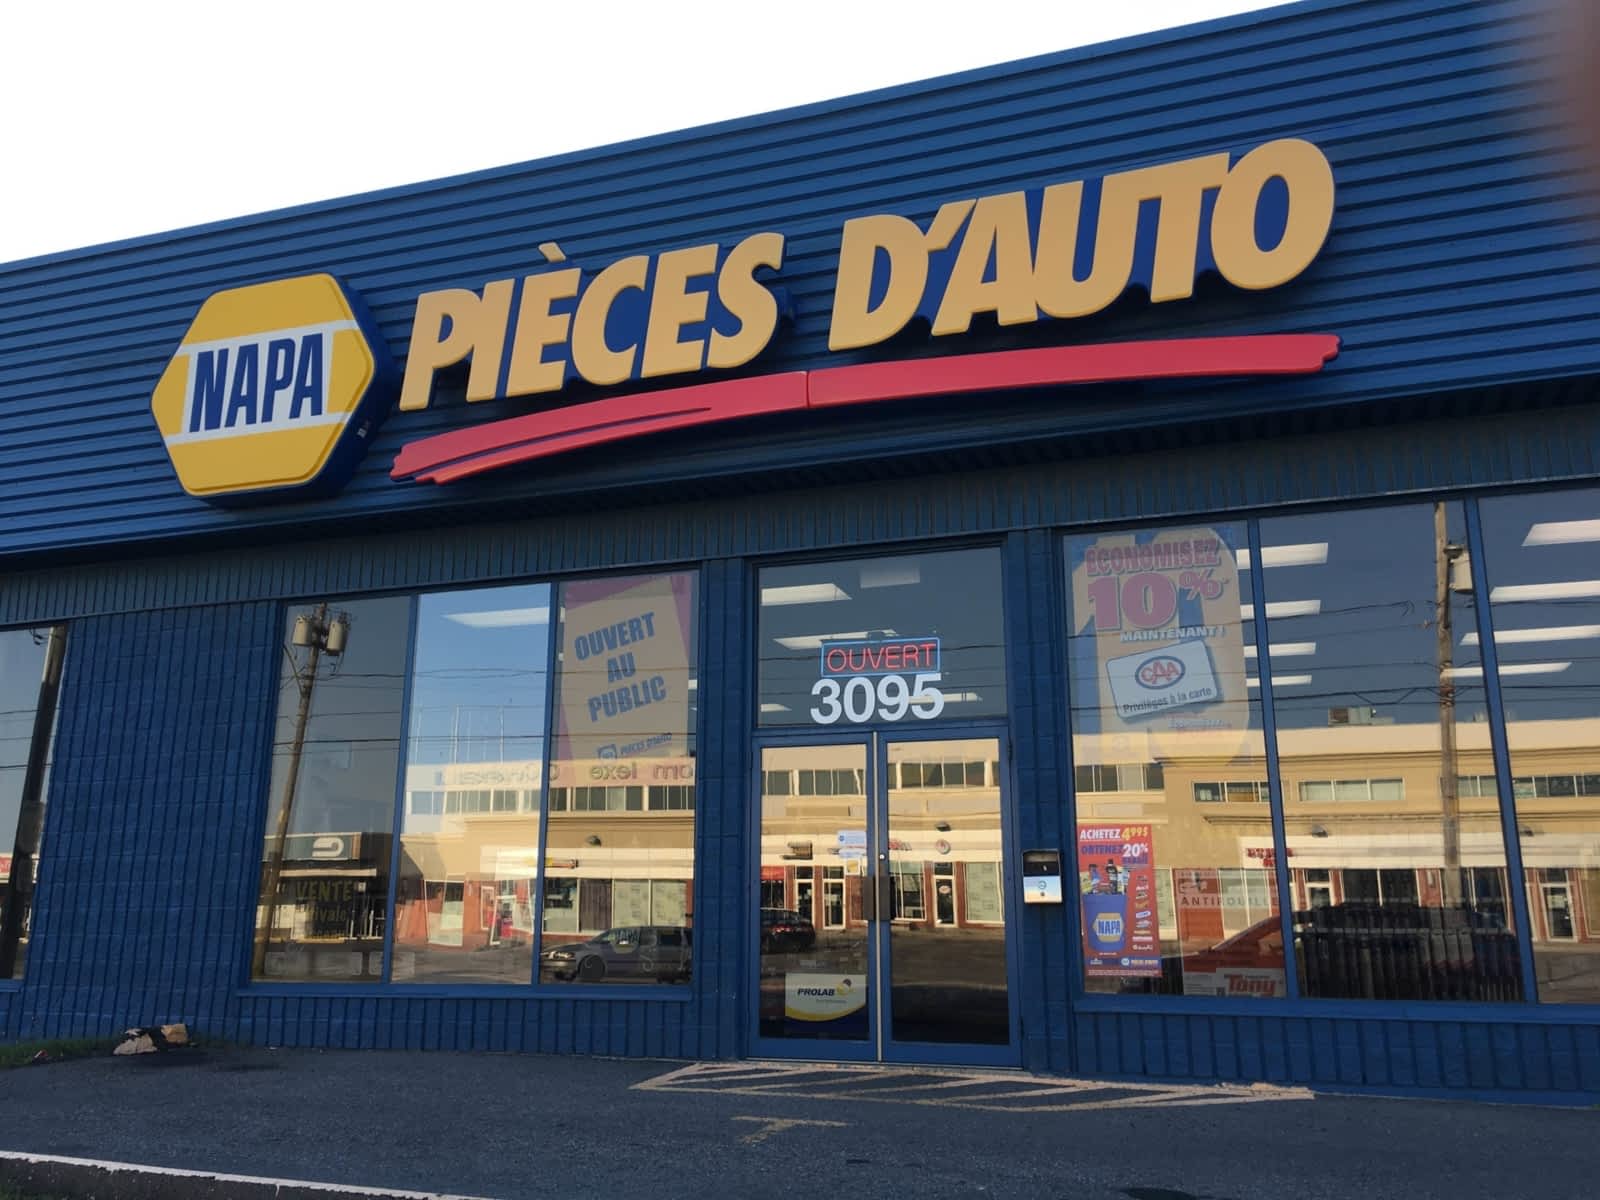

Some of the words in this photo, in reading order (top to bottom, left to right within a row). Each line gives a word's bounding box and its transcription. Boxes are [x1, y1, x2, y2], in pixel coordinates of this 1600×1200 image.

[399, 232, 785, 412] PIÈCES
[828, 138, 1336, 351] D'AUTO
[189, 332, 323, 433] NAPA
[574, 612, 655, 661] OUVERT
[606, 652, 637, 683] AU
[826, 642, 937, 673] OUVERT
[1140, 659, 1180, 685] CAA
[587, 676, 667, 722] PUBLIC
[810, 672, 945, 725] 3095
[1177, 690, 1188, 702] la
[1189, 686, 1213, 700] carte
[1080, 829, 1121, 840] ACHETEZ
[1122, 842, 1149, 857] 20%
[295, 879, 353, 903] VENTE
[1097, 919, 1121, 935] NAPA
[797, 987, 836, 997] PROLAB
